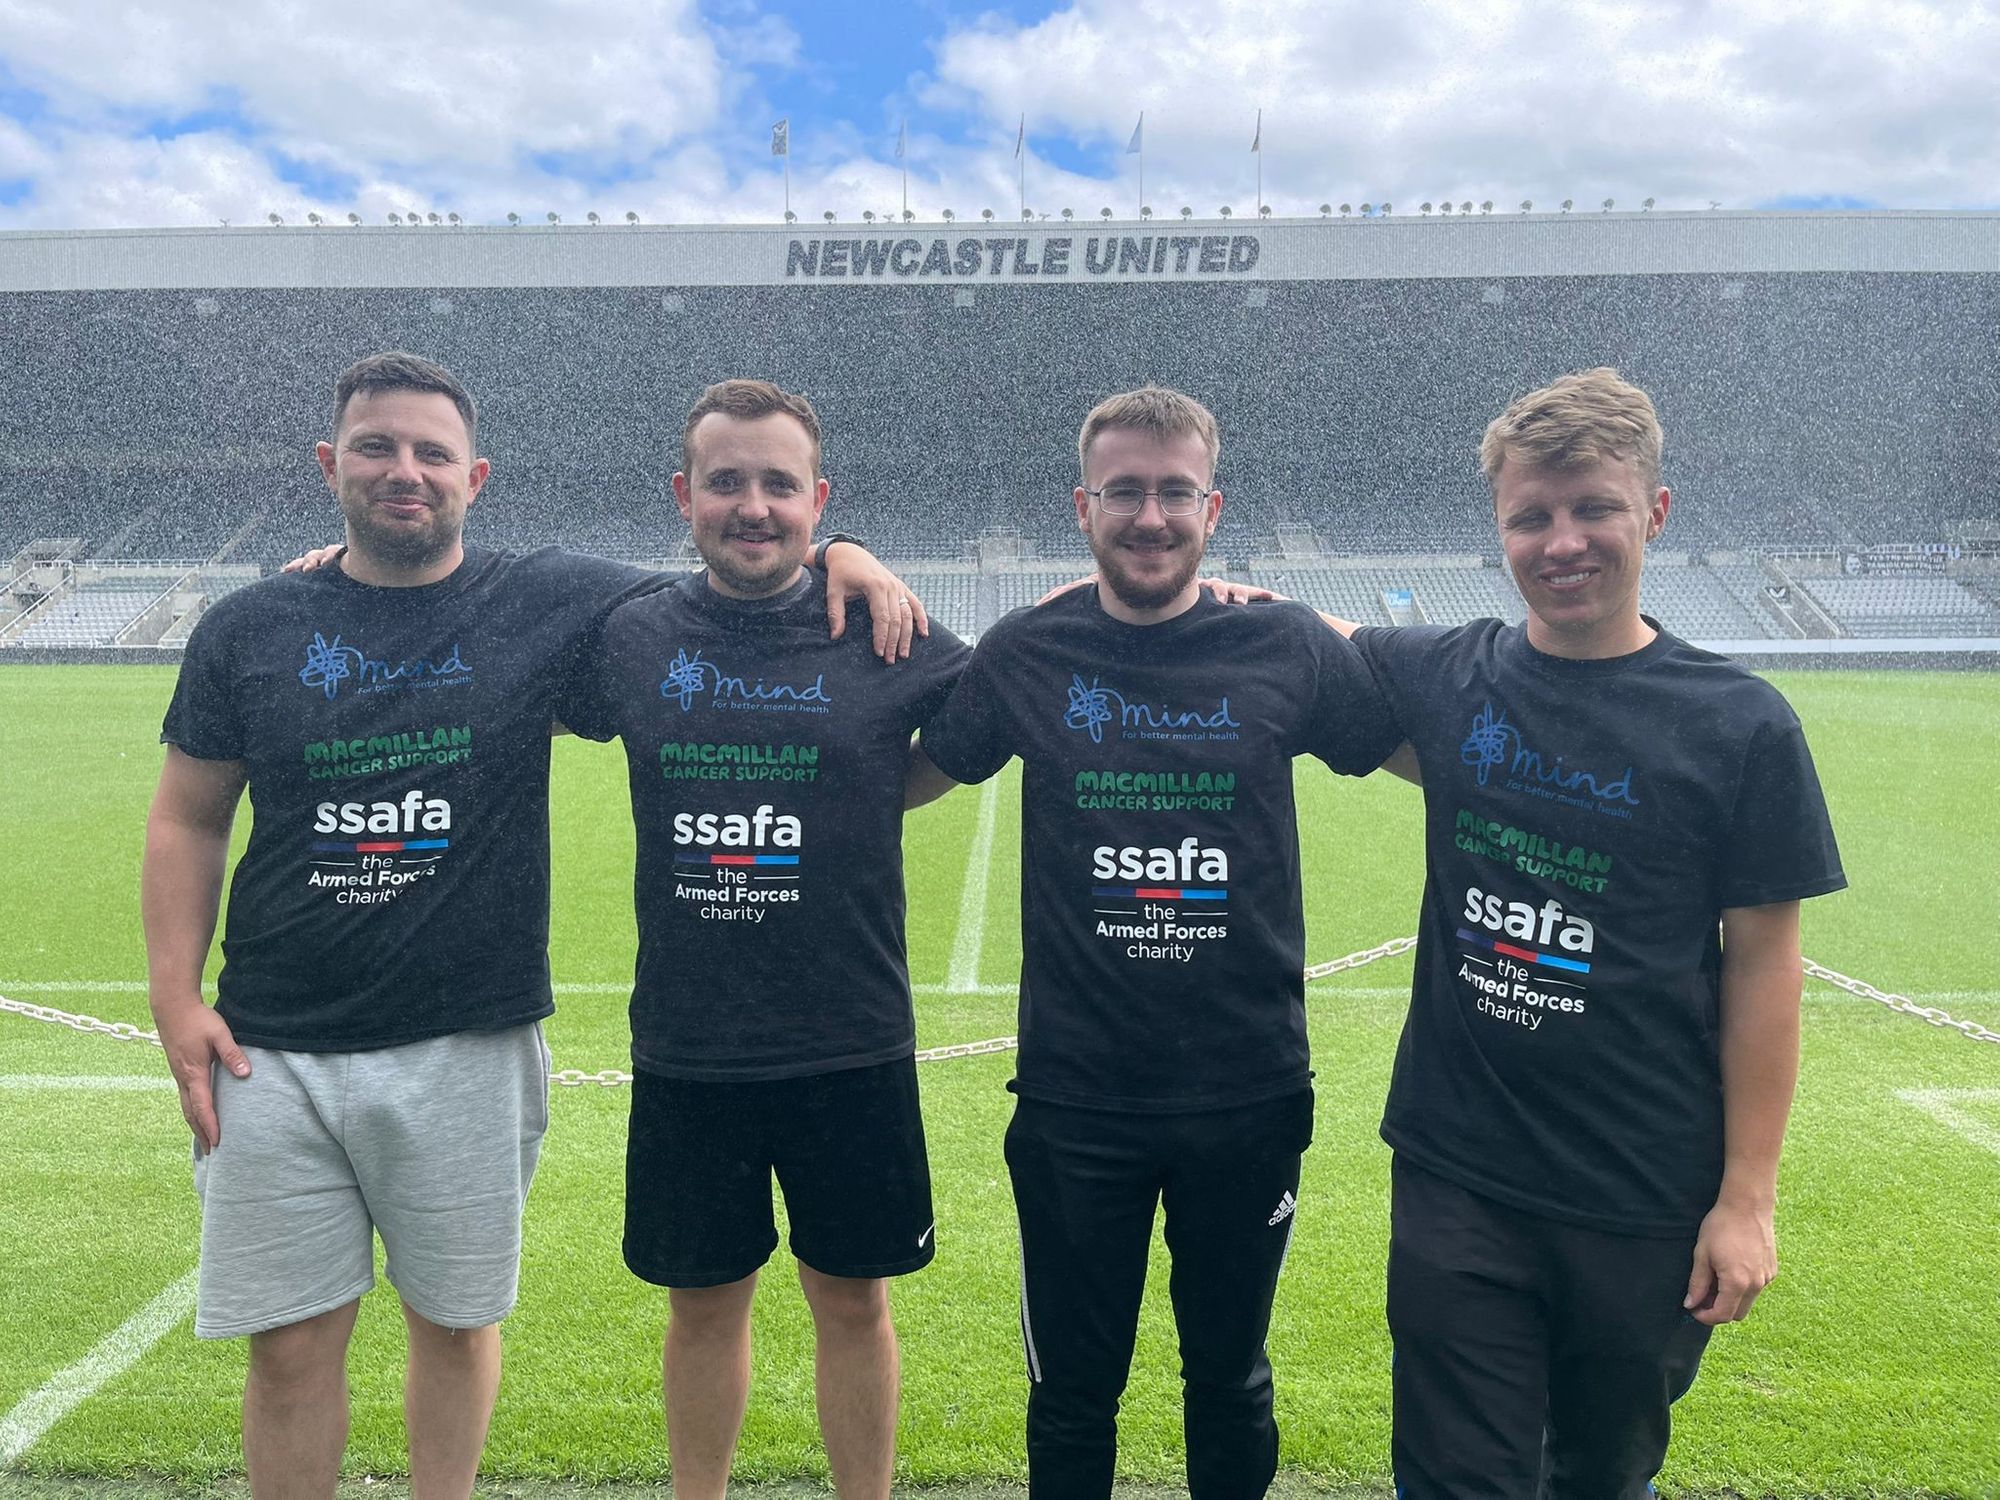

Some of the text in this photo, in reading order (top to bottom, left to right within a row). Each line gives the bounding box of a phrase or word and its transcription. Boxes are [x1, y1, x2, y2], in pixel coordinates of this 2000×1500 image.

[785, 235, 1261, 277] NEWCASTLE UNITED
[358, 643, 472, 683] mind
[443, 675, 472, 686] health
[714, 674, 831, 702] mind
[712, 700, 829, 714] For better mental health
[1121, 696, 1240, 728] mind
[303, 726, 472, 763] MACMILLAN
[1122, 731, 1239, 741] For better mental health
[308, 747, 472, 779] CANCER SUPPORT
[660, 742, 818, 765] MACMILLAN
[663, 765, 818, 783] CANCER SUPPORT
[1075, 770, 1235, 793] MACMILLAN
[1511, 749, 1640, 805] mind
[313, 790, 451, 834] ssafa
[1076, 794, 1235, 811] CANCER SUPPORT
[1506, 779, 1522, 791] For
[1599, 801, 1632, 820] health
[673, 804, 801, 847] ssafa
[1455, 808, 1612, 873] MACMILLAN
[361, 854, 393, 870] the
[1092, 837, 1228, 882] ssafa
[308, 864, 436, 887] Armed Forcs
[716, 868, 747, 884] the
[1515, 855, 1608, 893] SUPPORT
[675, 883, 799, 903] Armed Forces
[700, 904, 765, 923] charity
[1144, 903, 1175, 920] the
[1463, 887, 1594, 953] ssafa
[1096, 921, 1227, 940] Armed Forces
[1127, 942, 1194, 962] charity
[1497, 958, 1529, 982] the
[1512, 983, 1585, 1013] Forces
[1477, 996, 1543, 1031] charity
